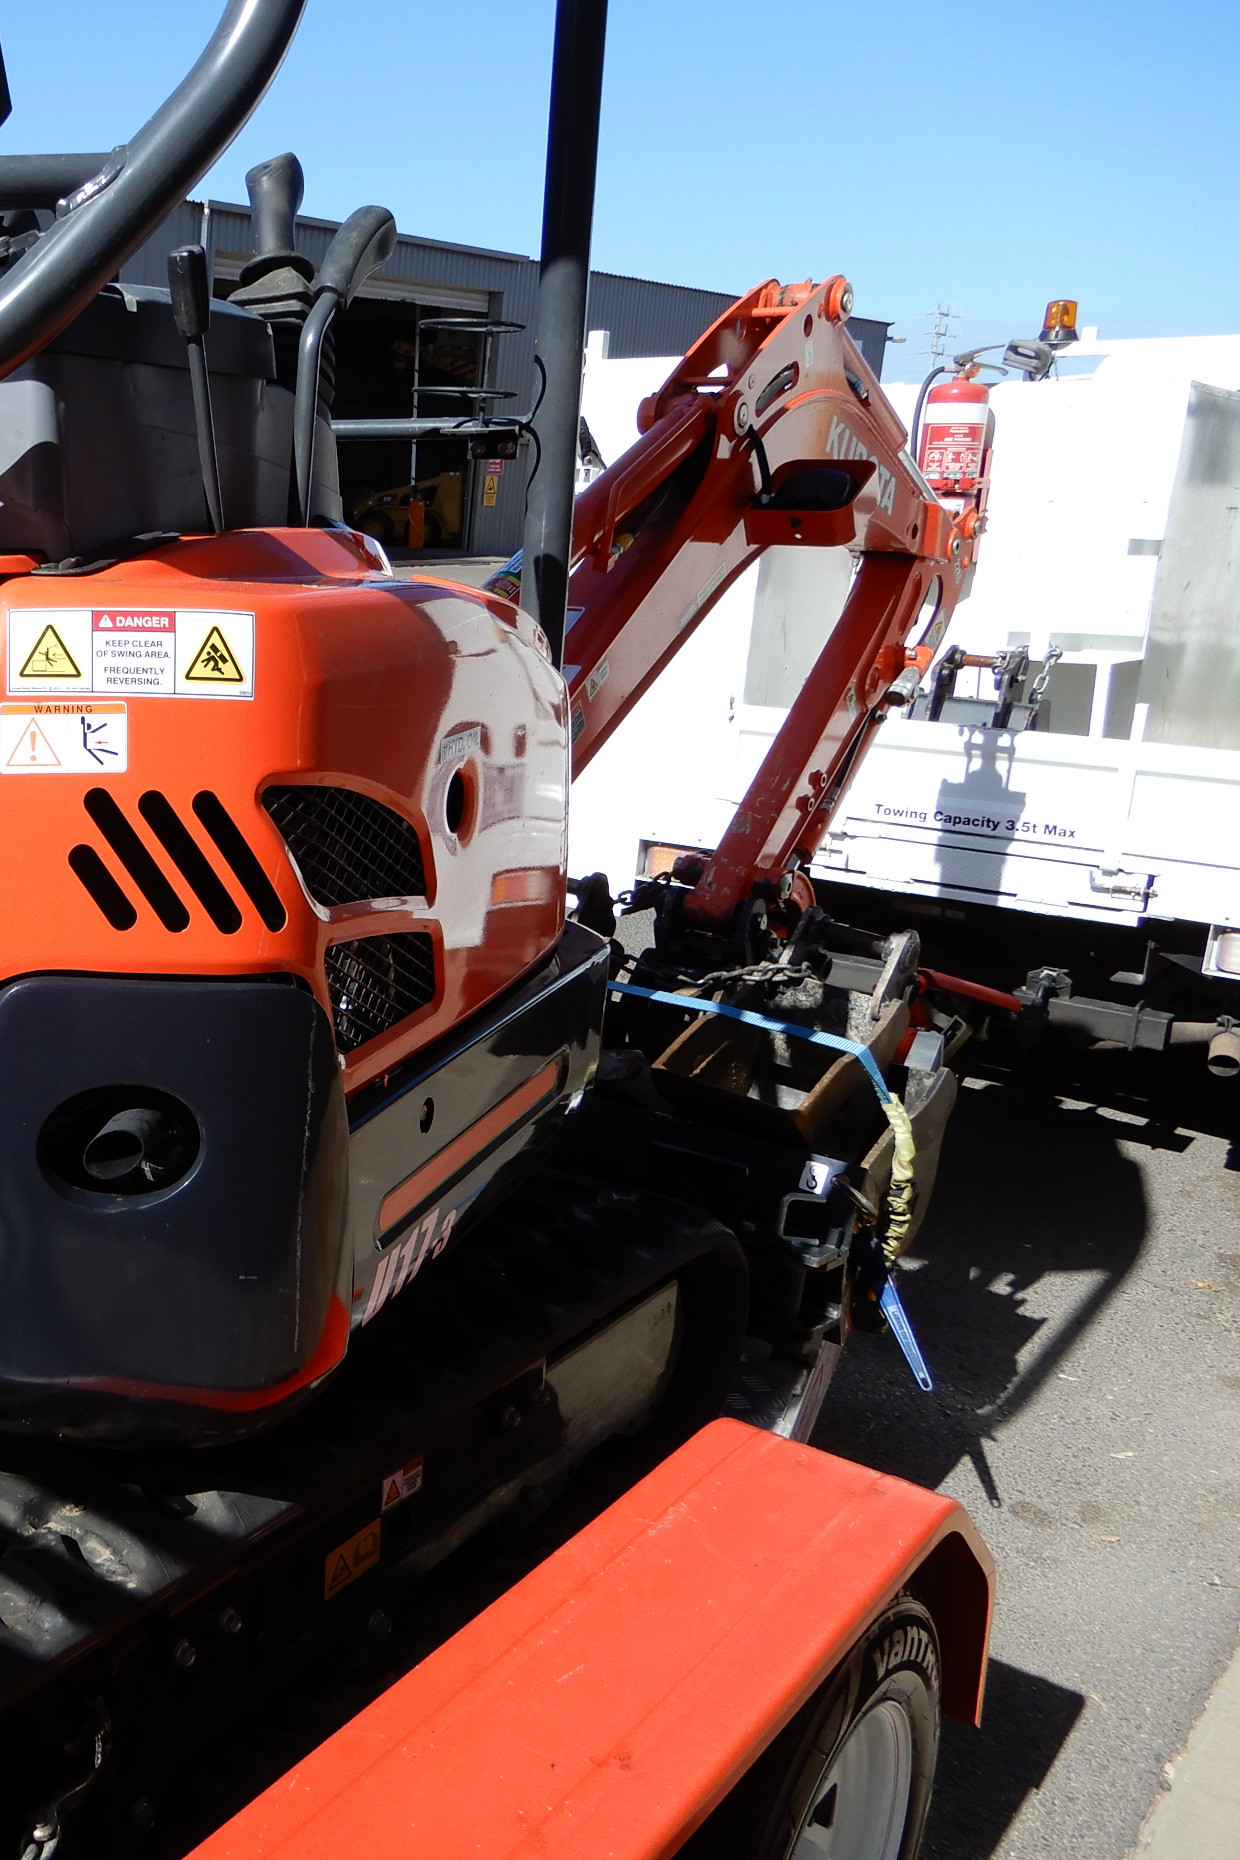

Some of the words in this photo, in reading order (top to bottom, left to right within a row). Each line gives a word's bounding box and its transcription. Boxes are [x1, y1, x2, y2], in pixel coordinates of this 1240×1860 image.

[825, 414, 896, 516] KUTA
[115, 616, 169, 628] DANGER
[105, 639, 130, 648] KEEP
[131, 640, 163, 648] CLEAR
[110, 650, 142, 658] SWING
[144, 651, 171, 659] AREA.
[104, 666, 165, 675] FREQUENTLY
[106, 677, 162, 685] REVERSING.
[34, 704, 93, 714] WARNING
[875, 803, 927, 822] Towing
[933, 810, 1000, 831] Capacity
[1005, 819, 1038, 834] 3.5t
[1043, 824, 1076, 838] Max
